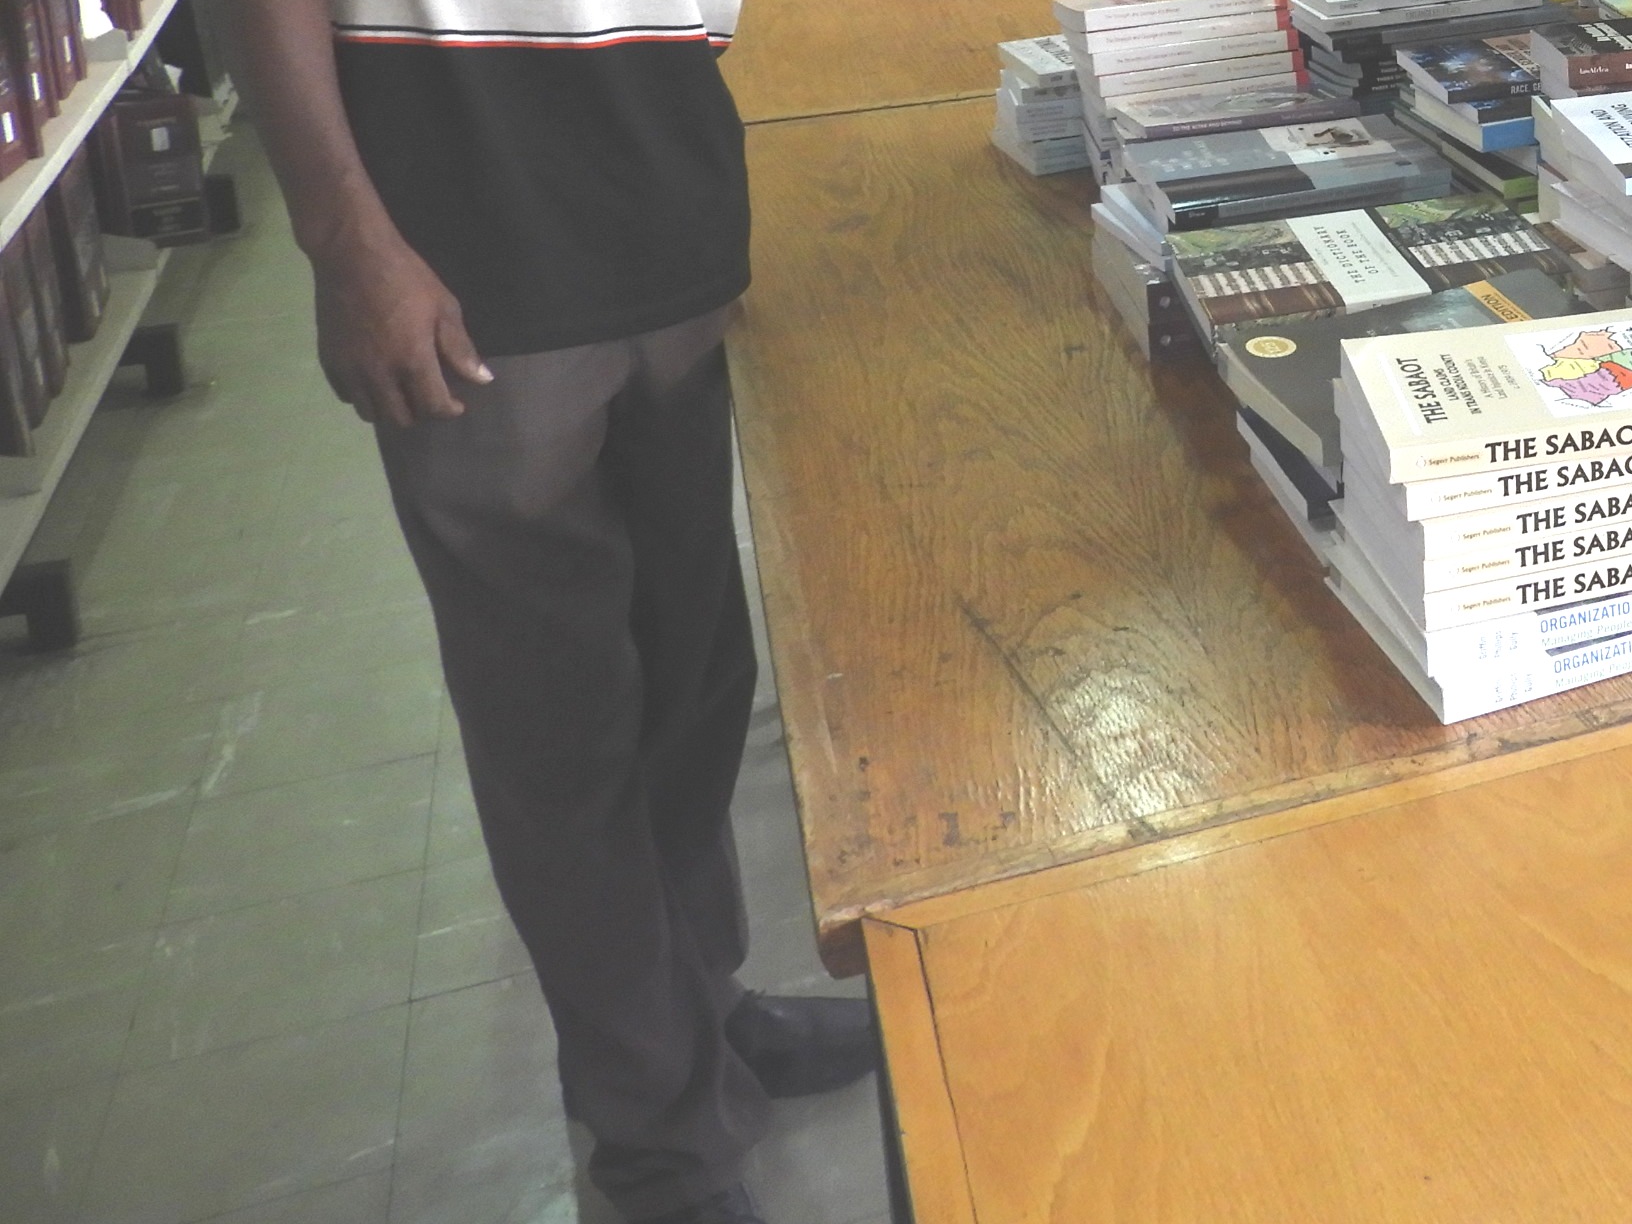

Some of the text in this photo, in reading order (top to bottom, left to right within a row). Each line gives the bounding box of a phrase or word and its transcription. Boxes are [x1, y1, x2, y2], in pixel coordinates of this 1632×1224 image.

[1591, 109, 1613, 124] AND
[1314, 226, 1365, 283] THE DICTIONARY
[1352, 250, 1370, 263] THE
[1482, 294, 1519, 320] EDITION
[1396, 358, 1448, 424] THE SABAOT
[1444, 386, 1459, 402] LAND
[1450, 454, 1479, 462] Publishers
[1485, 437, 1537, 463] THE
[1464, 489, 1492, 497] Publishers
[1498, 469, 1548, 496] THE
[1483, 527, 1511, 536] Publishers
[1516, 506, 1566, 534] THE
[1482, 559, 1510, 569] Publishers
[1515, 540, 1565, 567] THE
[1483, 596, 1511, 606] Publishers
[1516, 577, 1566, 604] THE
